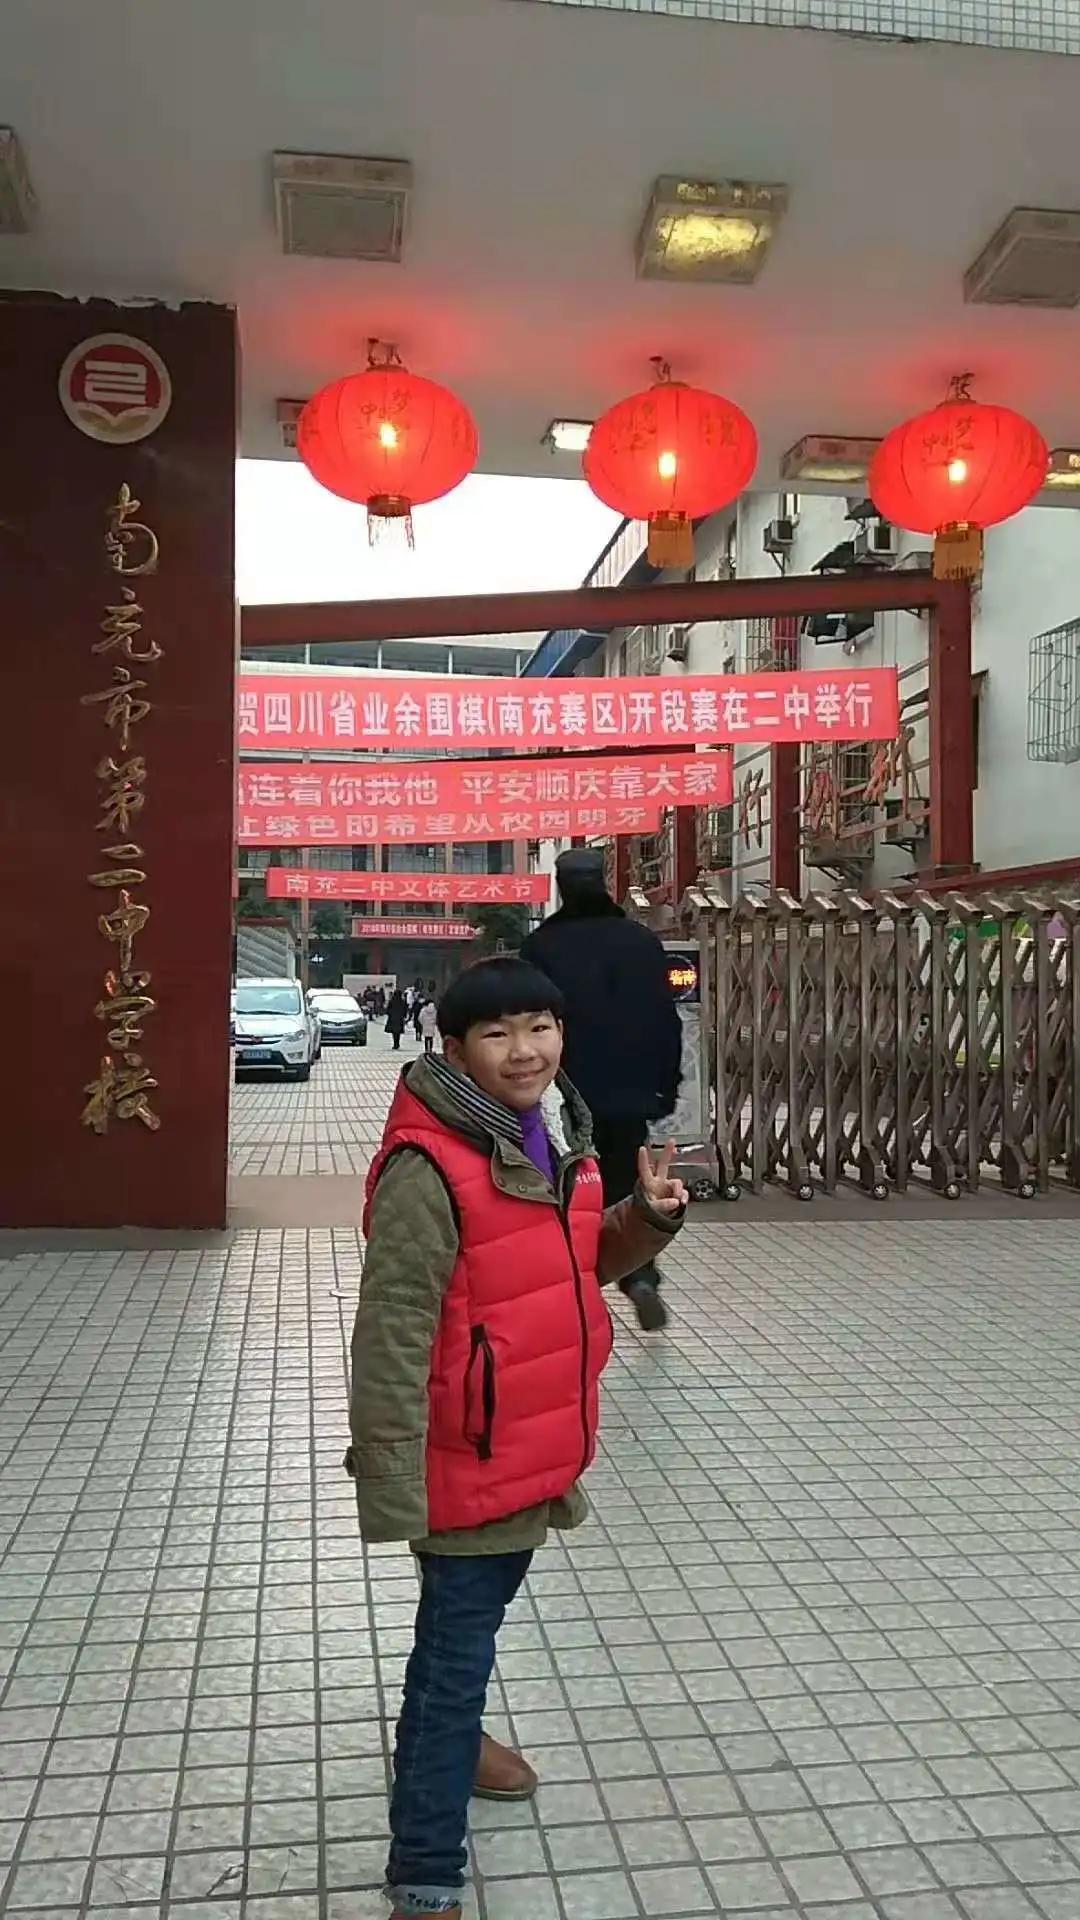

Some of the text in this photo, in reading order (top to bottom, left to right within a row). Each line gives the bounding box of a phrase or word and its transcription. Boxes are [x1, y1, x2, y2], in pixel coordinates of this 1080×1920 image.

[239, 761, 719, 807] 连着你我他 平安顺庆靠大家
[80, 482, 162, 1135] 南充市第二中学校
[284, 873, 533, 899] 南充二中文体艺术节
